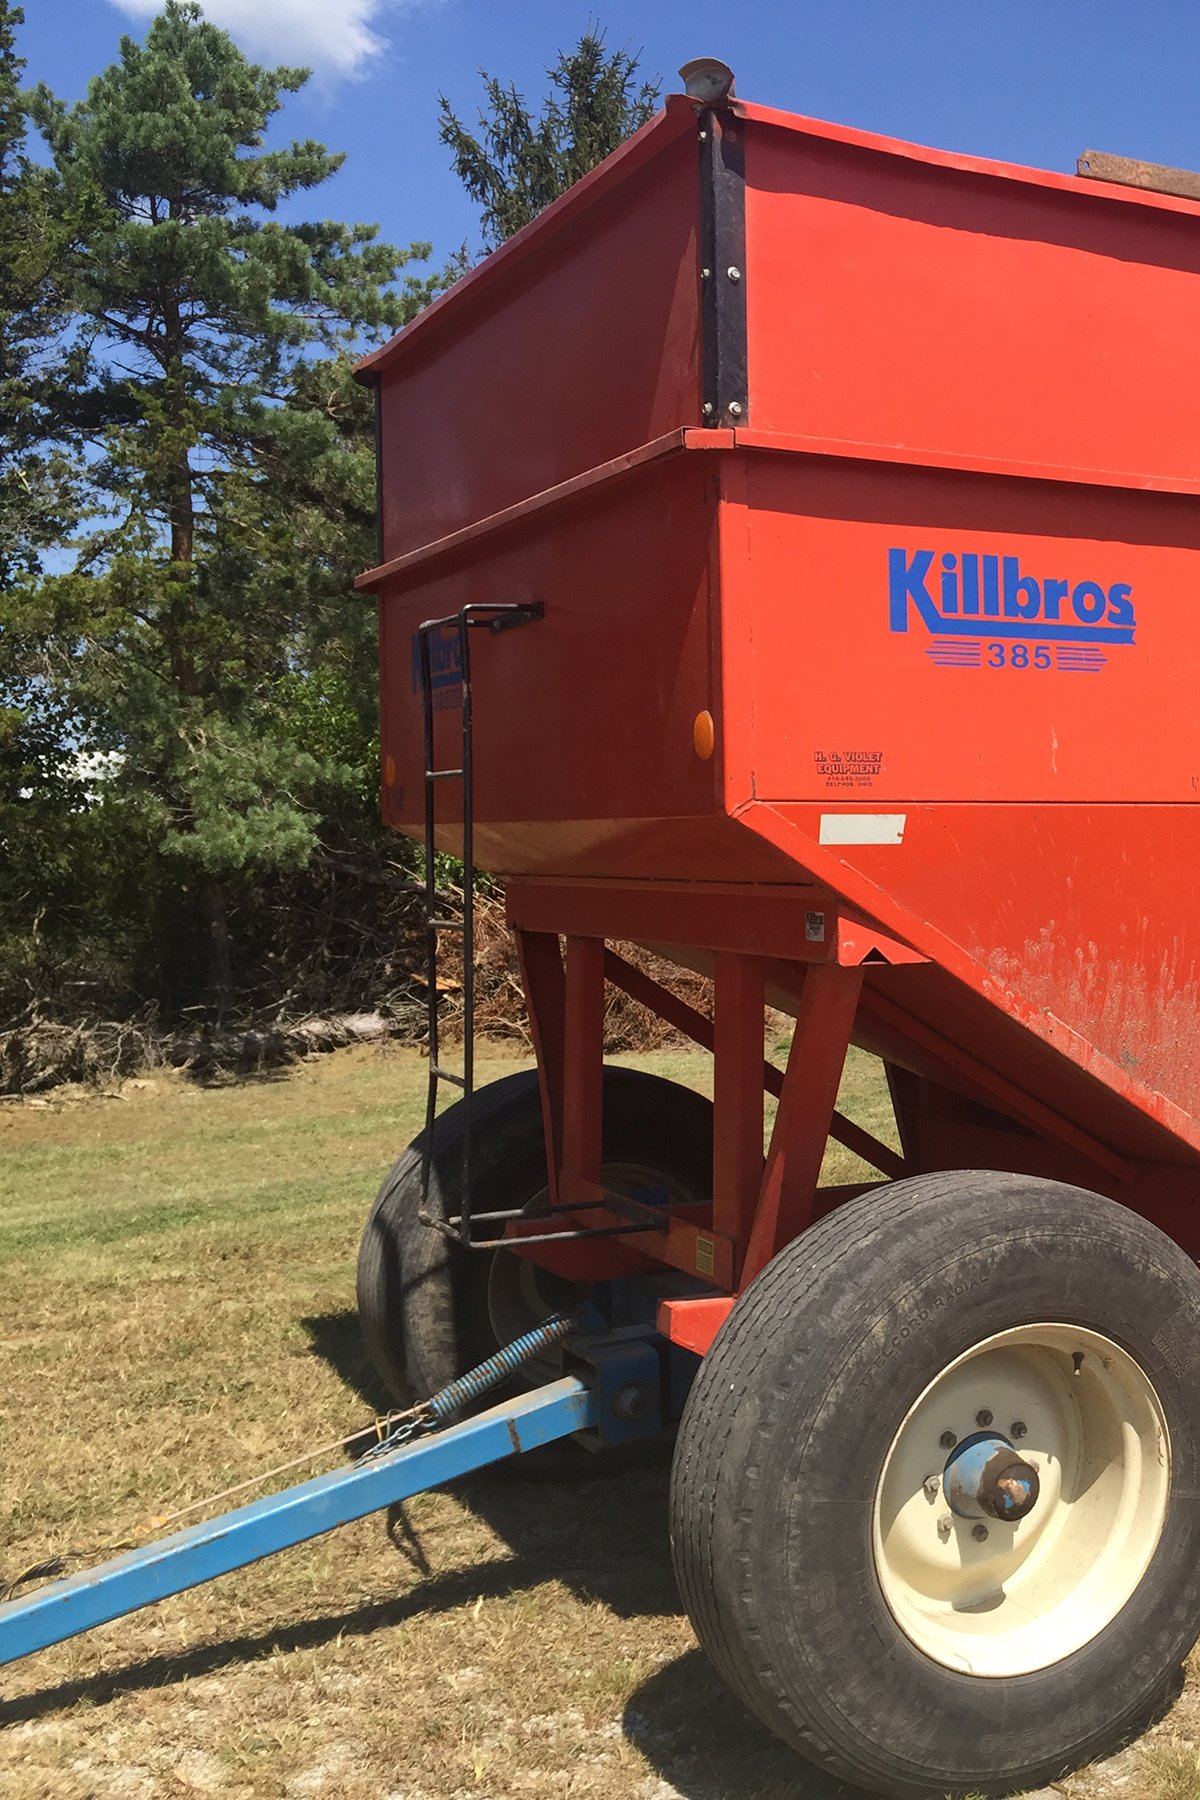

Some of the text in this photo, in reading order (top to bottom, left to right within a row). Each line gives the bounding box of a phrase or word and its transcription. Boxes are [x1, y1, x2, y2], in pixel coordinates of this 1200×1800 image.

[888, 547, 1137, 635] Killbros
[987, 642, 1052, 669] 385
[813, 751, 883, 762] H. G. VIOLET
[817, 763, 882, 775] EQUIPMENT
